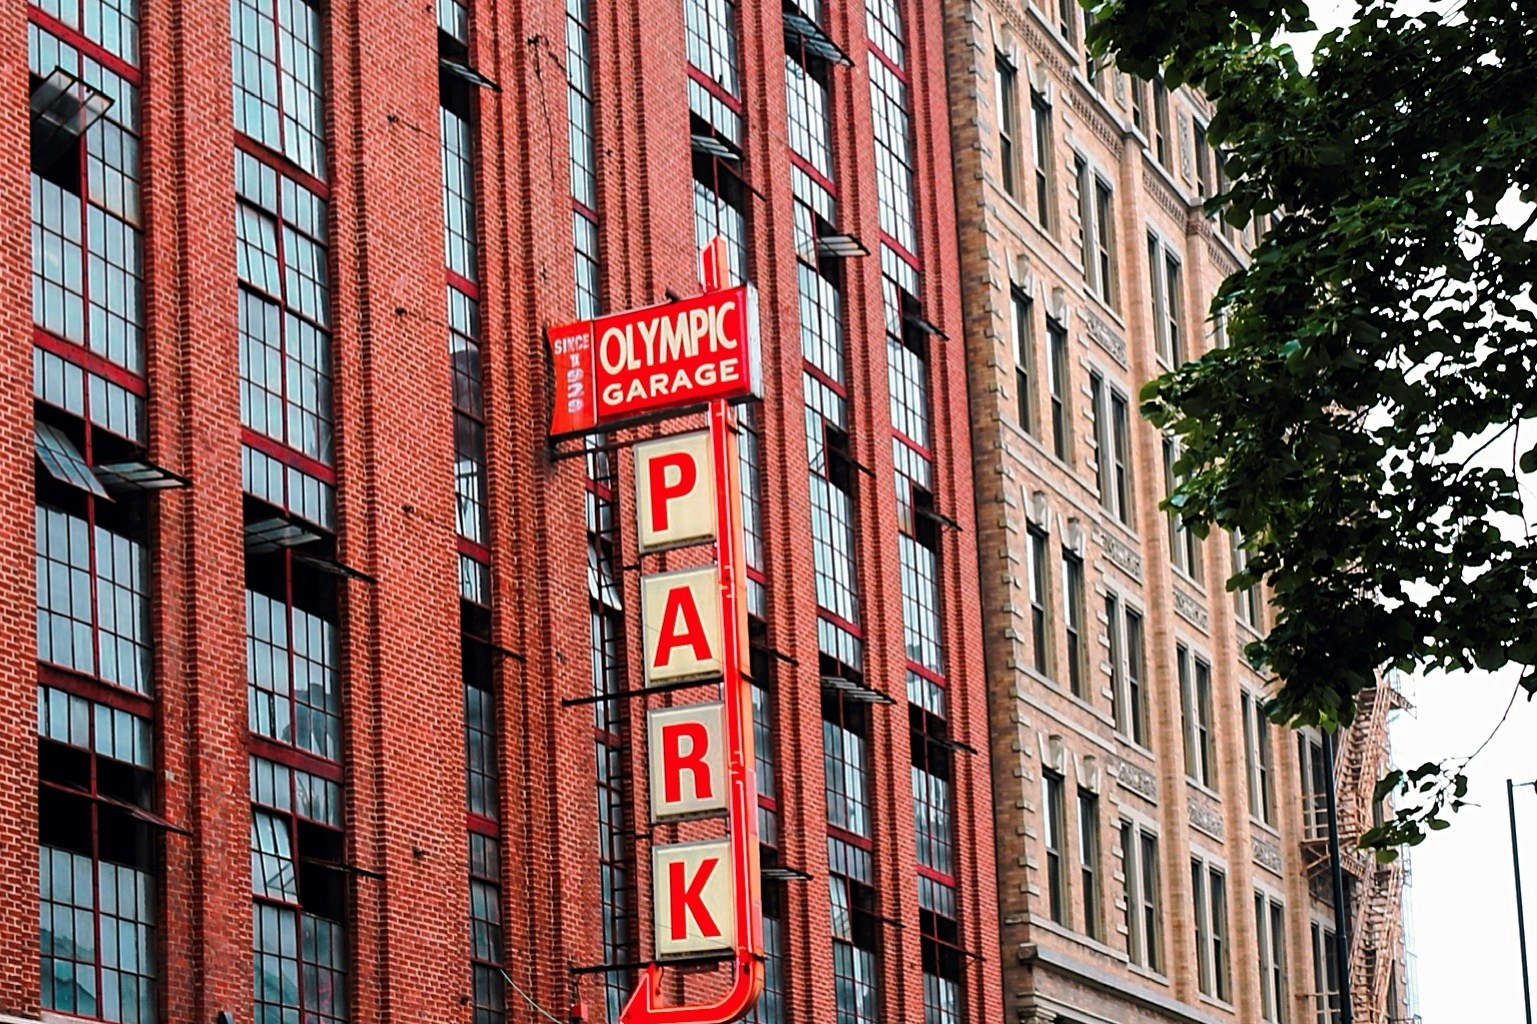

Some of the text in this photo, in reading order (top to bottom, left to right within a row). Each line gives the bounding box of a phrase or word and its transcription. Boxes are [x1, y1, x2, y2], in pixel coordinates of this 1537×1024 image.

[554, 333, 590, 355] SINCE
[599, 301, 738, 375] OLYMPIC
[602, 357, 740, 406] GARAGE
[647, 450, 722, 942] PARK
